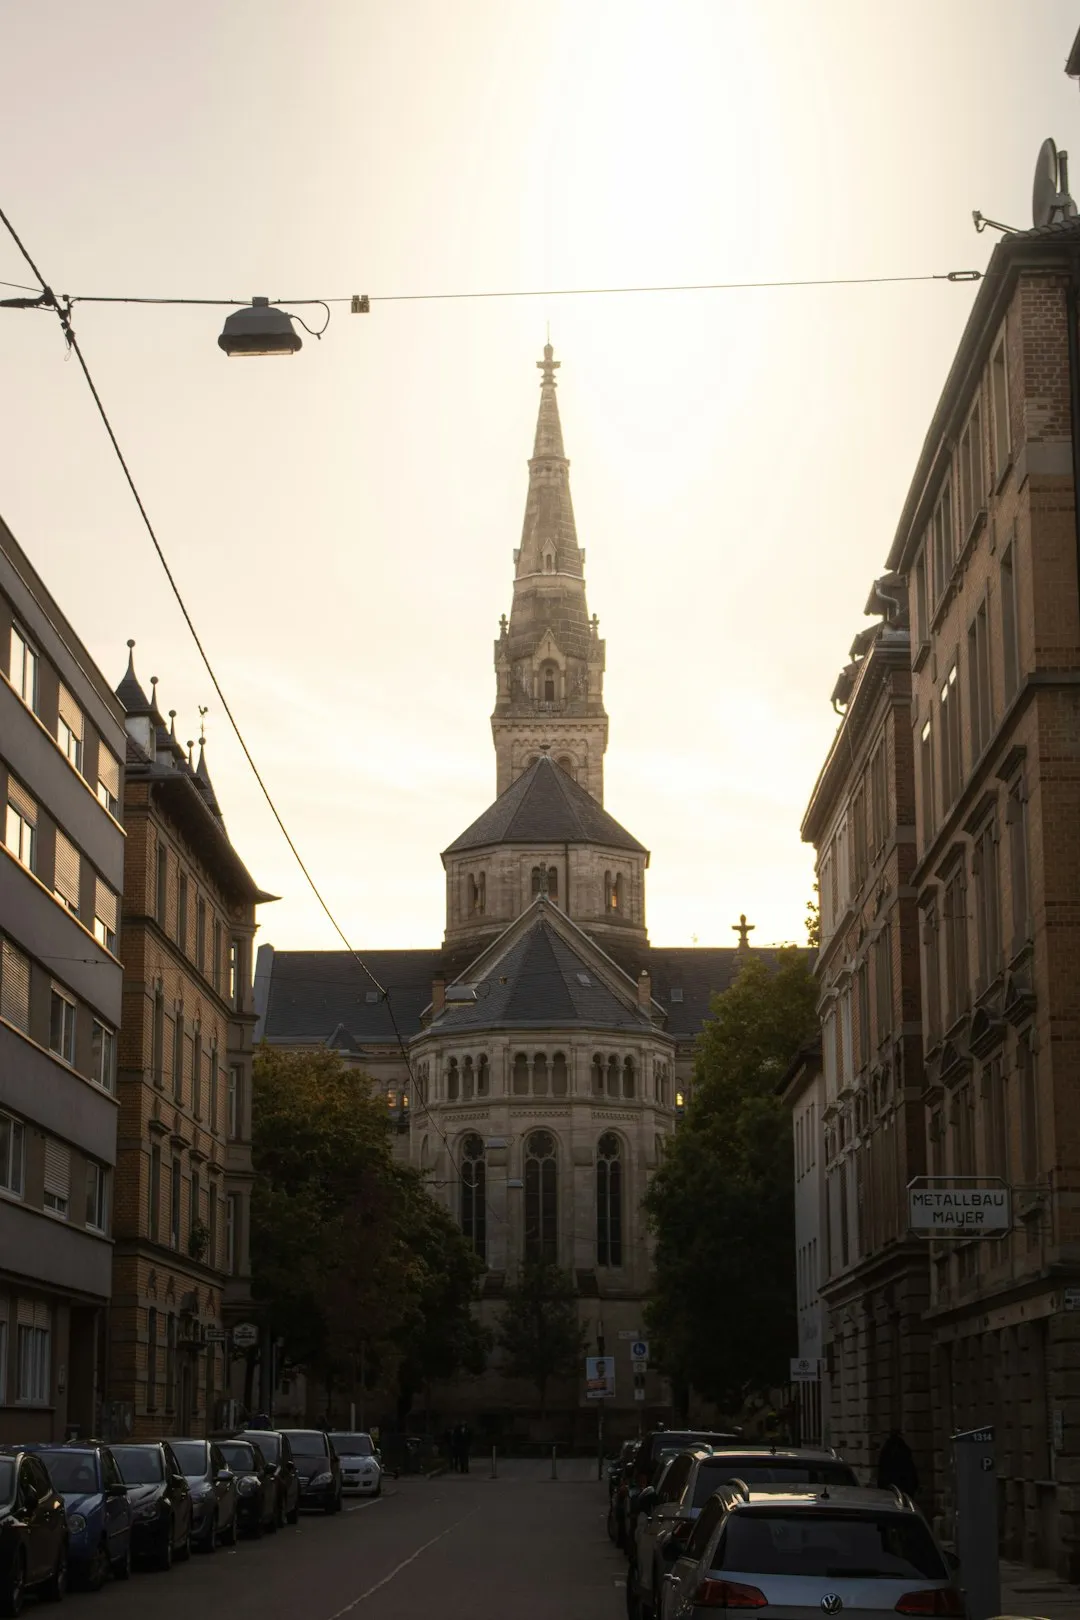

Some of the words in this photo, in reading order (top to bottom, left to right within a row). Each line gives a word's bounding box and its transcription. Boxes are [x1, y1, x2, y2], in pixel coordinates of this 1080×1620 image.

[913, 1194, 1004, 1206] METALLBAU
[972, 1432, 992, 1441] 1314
[983, 1457, 992, 1470] P
